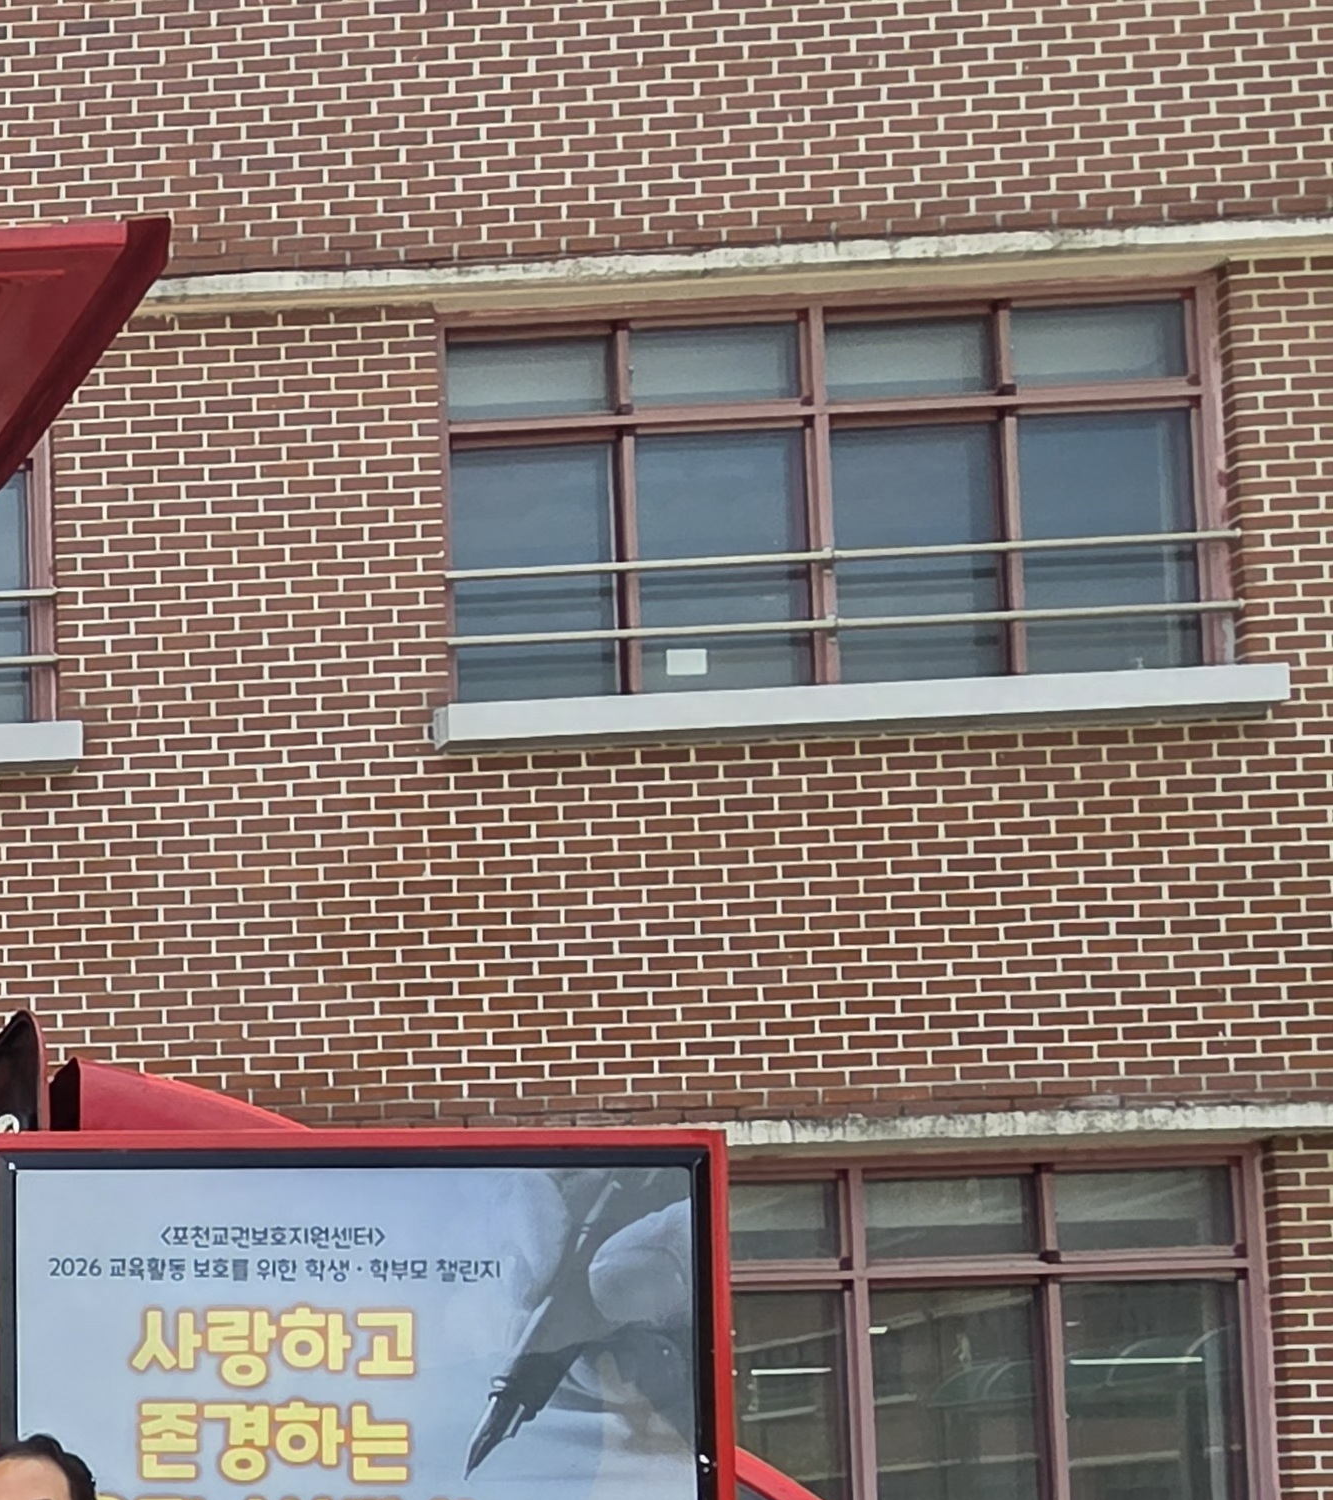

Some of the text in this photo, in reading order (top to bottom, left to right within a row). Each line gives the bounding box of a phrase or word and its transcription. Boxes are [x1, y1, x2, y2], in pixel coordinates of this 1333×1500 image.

[48, 1257, 102, 1278] 2026
[109, 1257, 185, 1281] 교육활동
[194, 1258, 248, 1282] 보호를
[257, 1258, 297, 1282] 위한
[305, 1257, 348, 1282] 학생
[369, 1258, 428, 1282] 학부모
[436, 1258, 501, 1283] 챌린지
[131, 1307, 415, 1388] 사랑하고
[140, 1401, 410, 1482] 존경하는
